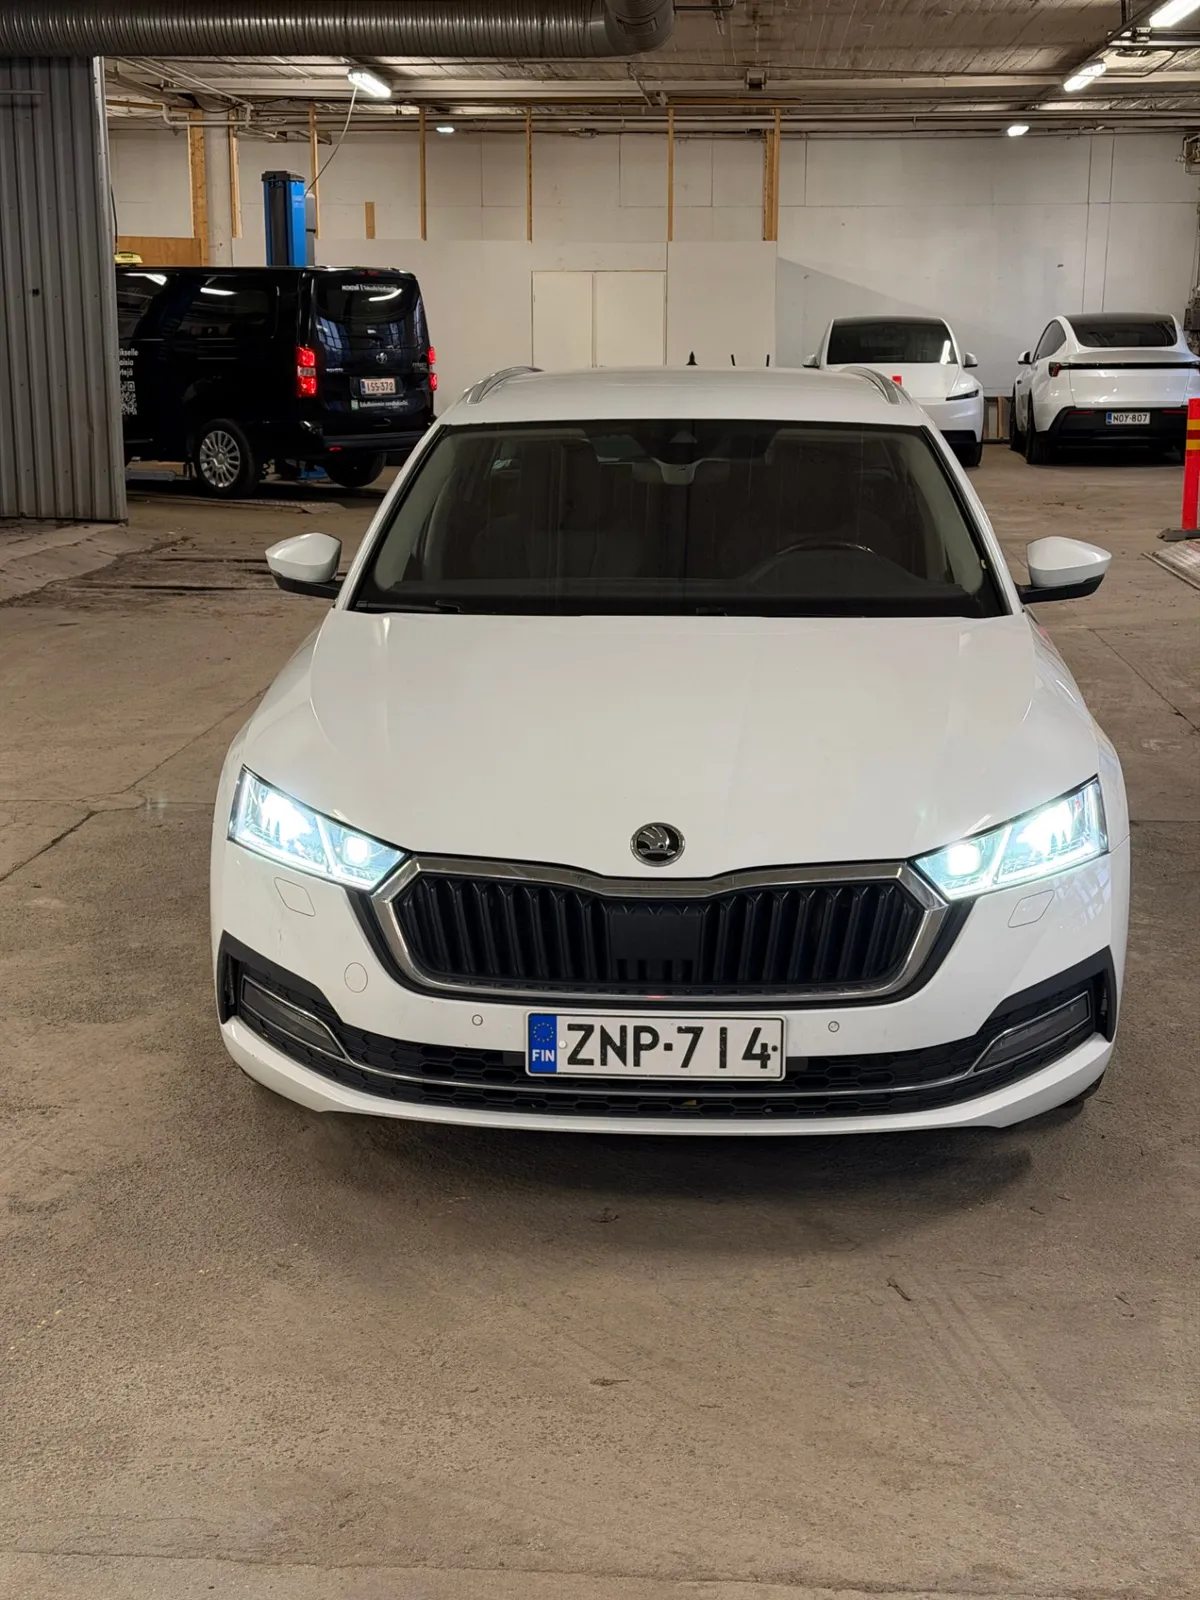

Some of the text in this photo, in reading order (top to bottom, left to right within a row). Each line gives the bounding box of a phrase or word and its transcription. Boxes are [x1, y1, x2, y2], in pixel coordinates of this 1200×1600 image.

[1113, 414, 1148, 422] NOY-807
[532, 1023, 771, 1069] FIN ZNP-714
